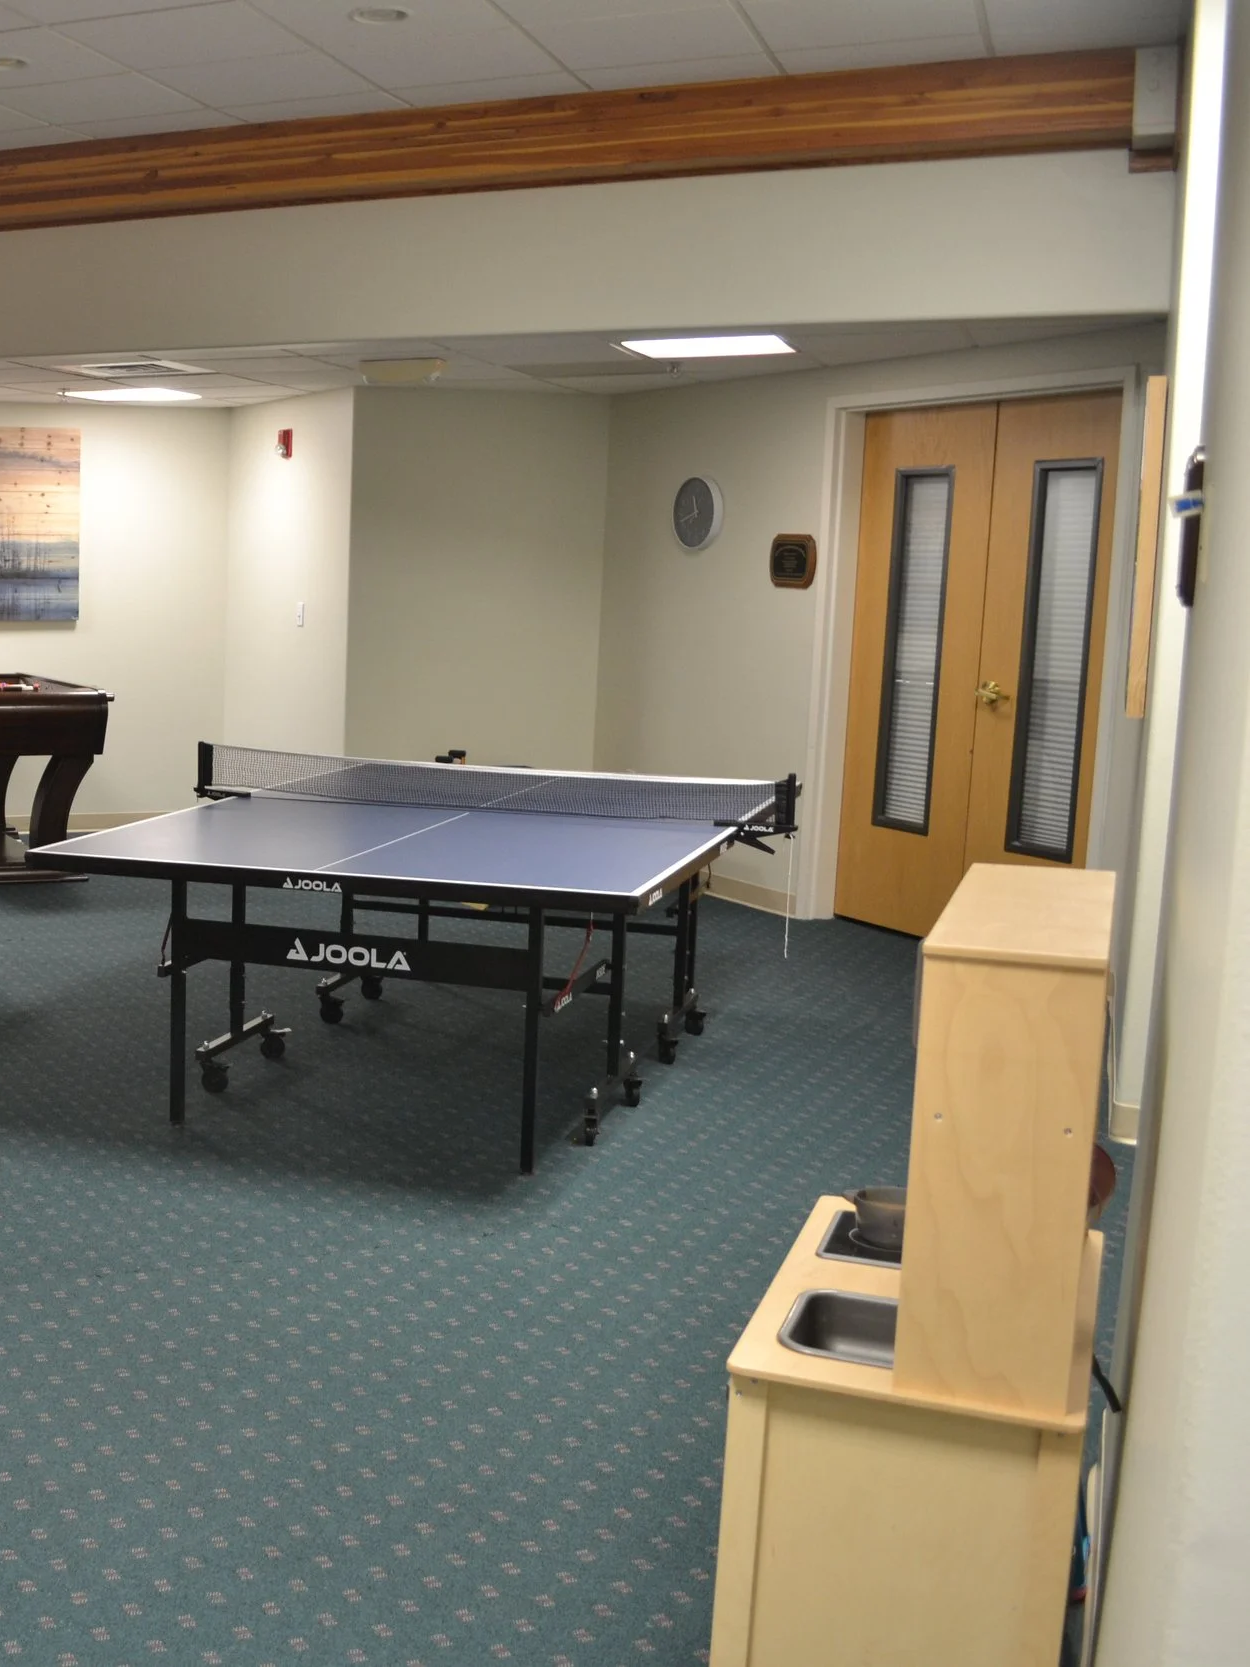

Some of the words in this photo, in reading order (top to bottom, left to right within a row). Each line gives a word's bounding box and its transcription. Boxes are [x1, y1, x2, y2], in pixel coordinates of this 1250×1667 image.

[750, 825, 774, 833] JOOLA
[294, 879, 343, 893] JOOLA
[310, 943, 411, 971] JOOLA
